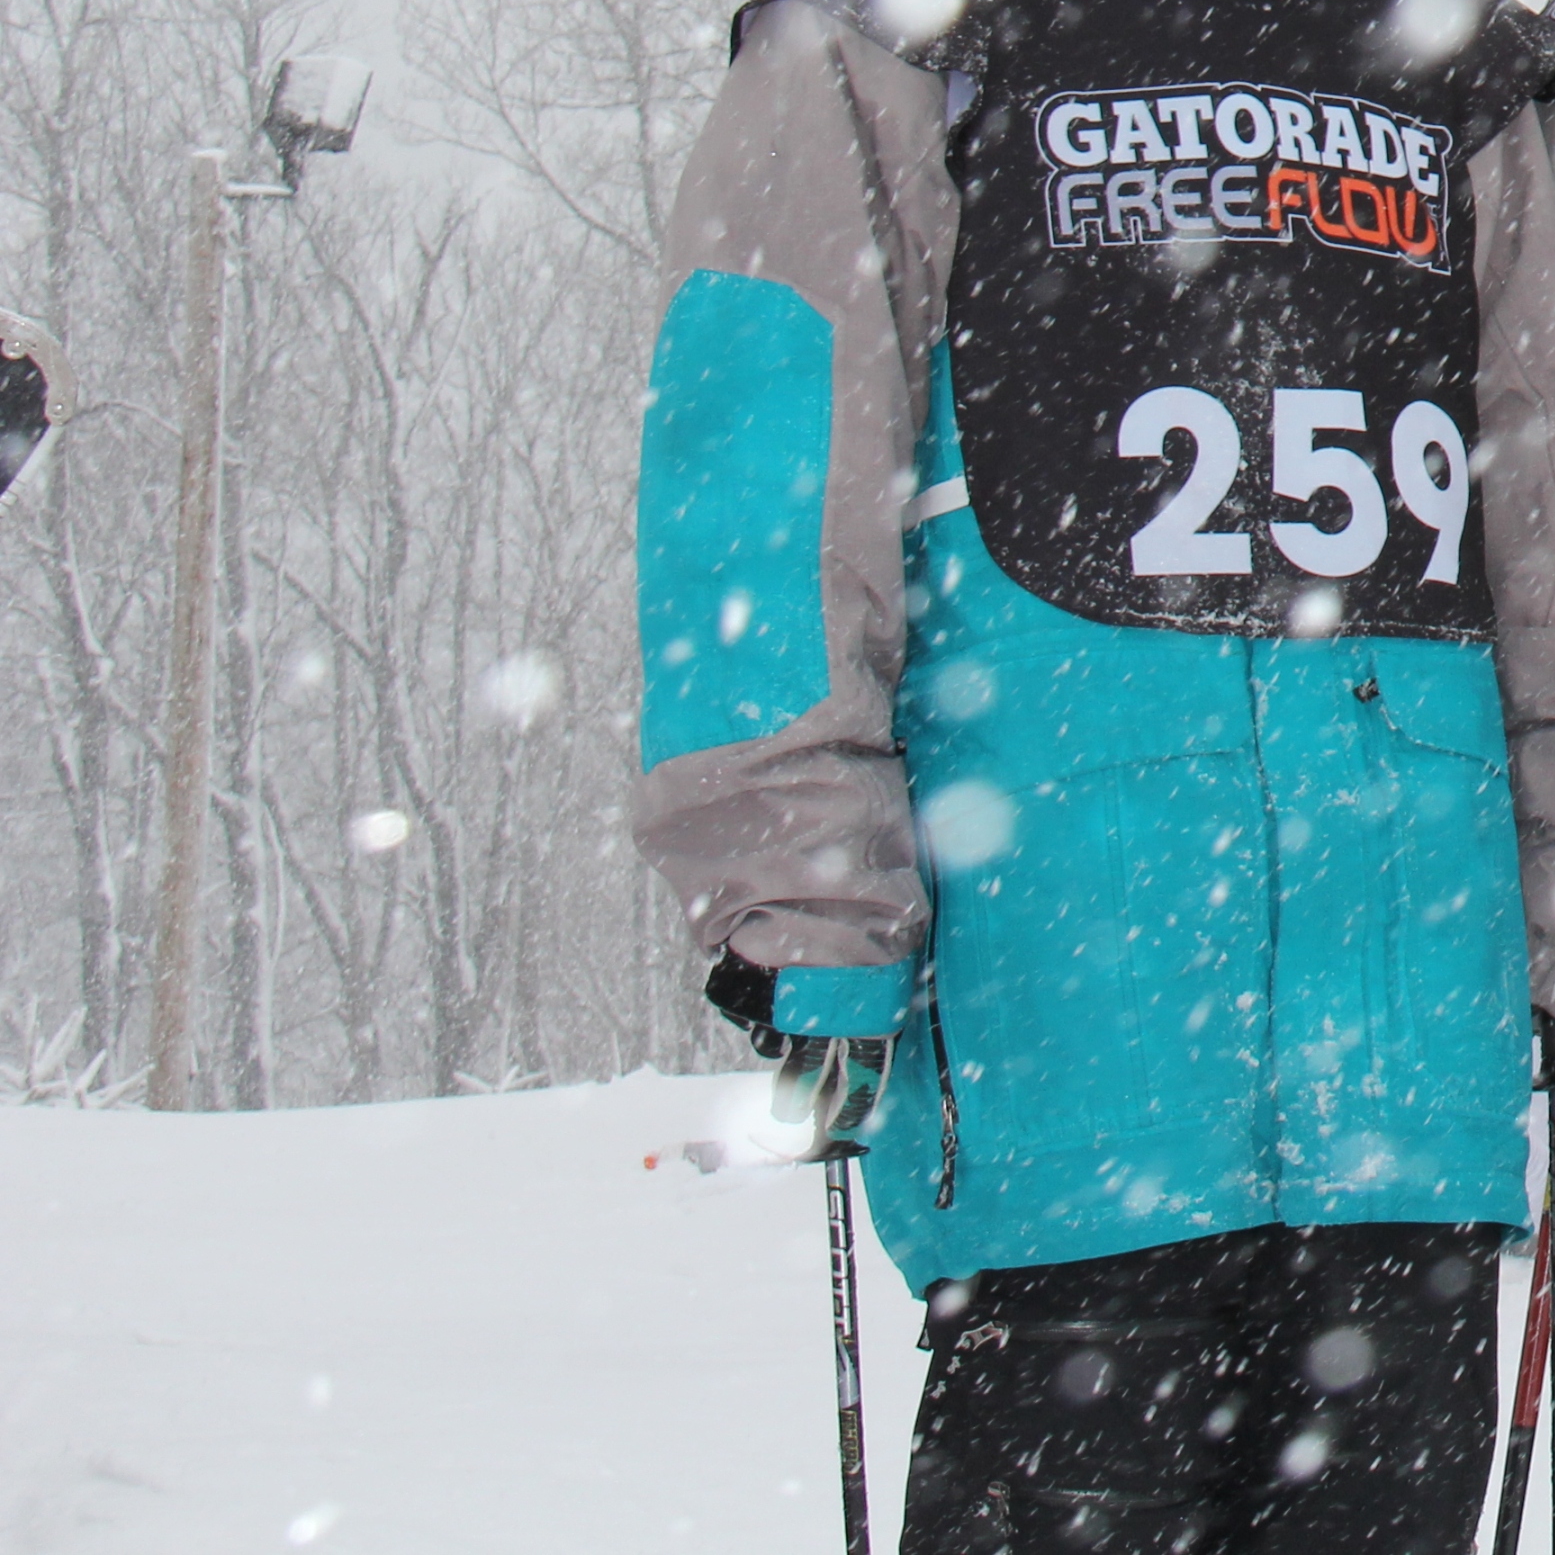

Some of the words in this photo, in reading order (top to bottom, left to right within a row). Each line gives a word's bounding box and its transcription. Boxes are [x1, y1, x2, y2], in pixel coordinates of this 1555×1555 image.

[1045, 93, 1441, 198] GATORADE
[1056, 165, 1262, 236] FREE
[1117, 385, 1470, 586] 259
